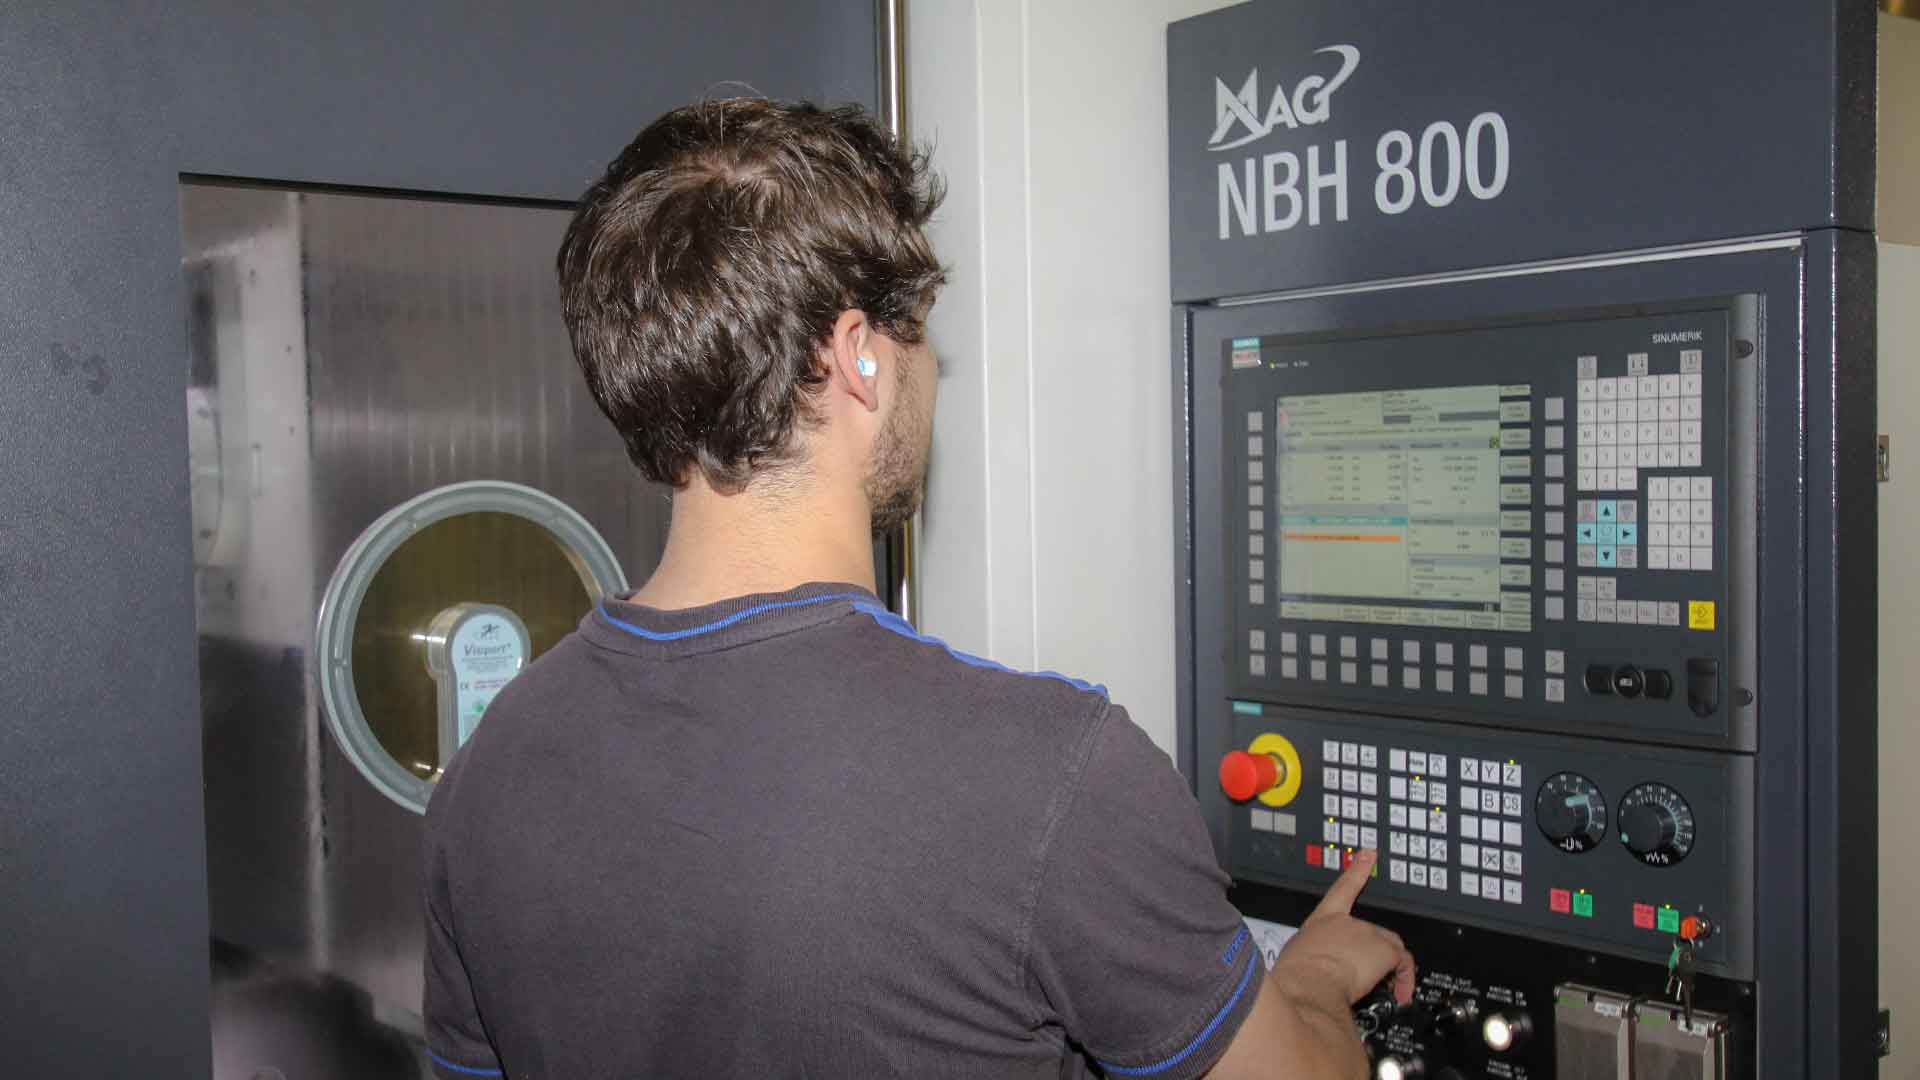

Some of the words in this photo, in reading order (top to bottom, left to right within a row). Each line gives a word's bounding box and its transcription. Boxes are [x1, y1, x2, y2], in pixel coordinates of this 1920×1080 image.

[1218, 139, 1349, 240] NBH
[1374, 112, 1510, 215] 800
[1652, 331, 1703, 344] SINUMERIK
[1464, 760, 1474, 777] X
[1485, 765, 1495, 779] Y
[1504, 766, 1516, 783] Z
[1484, 792, 1495, 809] B
[1503, 794, 1519, 811] CS
